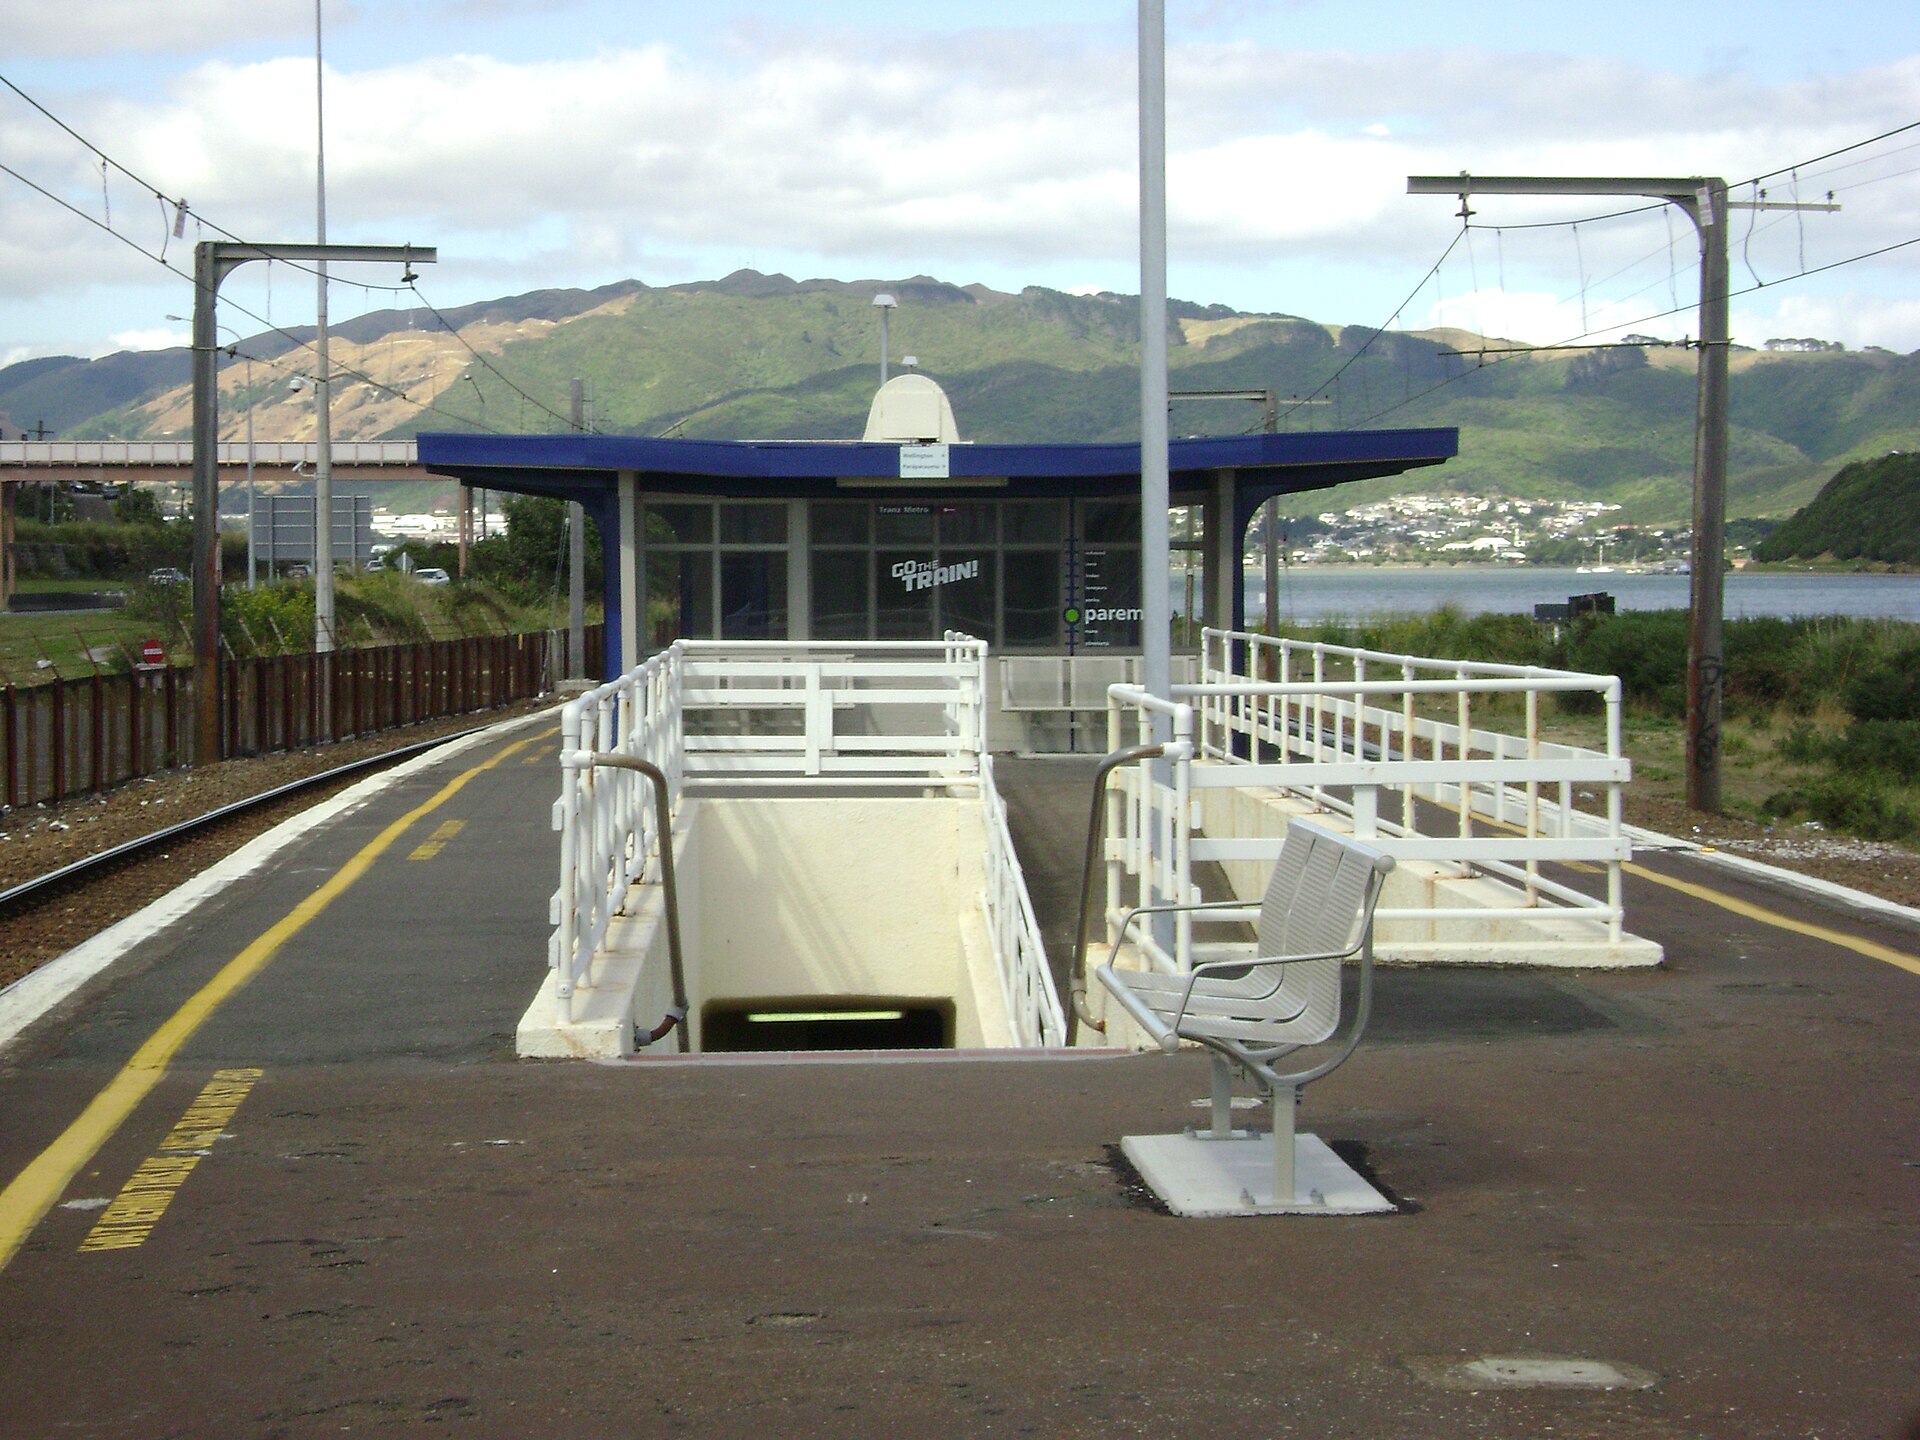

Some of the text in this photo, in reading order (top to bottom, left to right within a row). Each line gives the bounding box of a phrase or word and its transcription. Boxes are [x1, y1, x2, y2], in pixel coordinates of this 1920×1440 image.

[891, 560, 939, 578] GO THE
[901, 560, 979, 592] TRAIN!
[1085, 608, 1144, 624] parem
